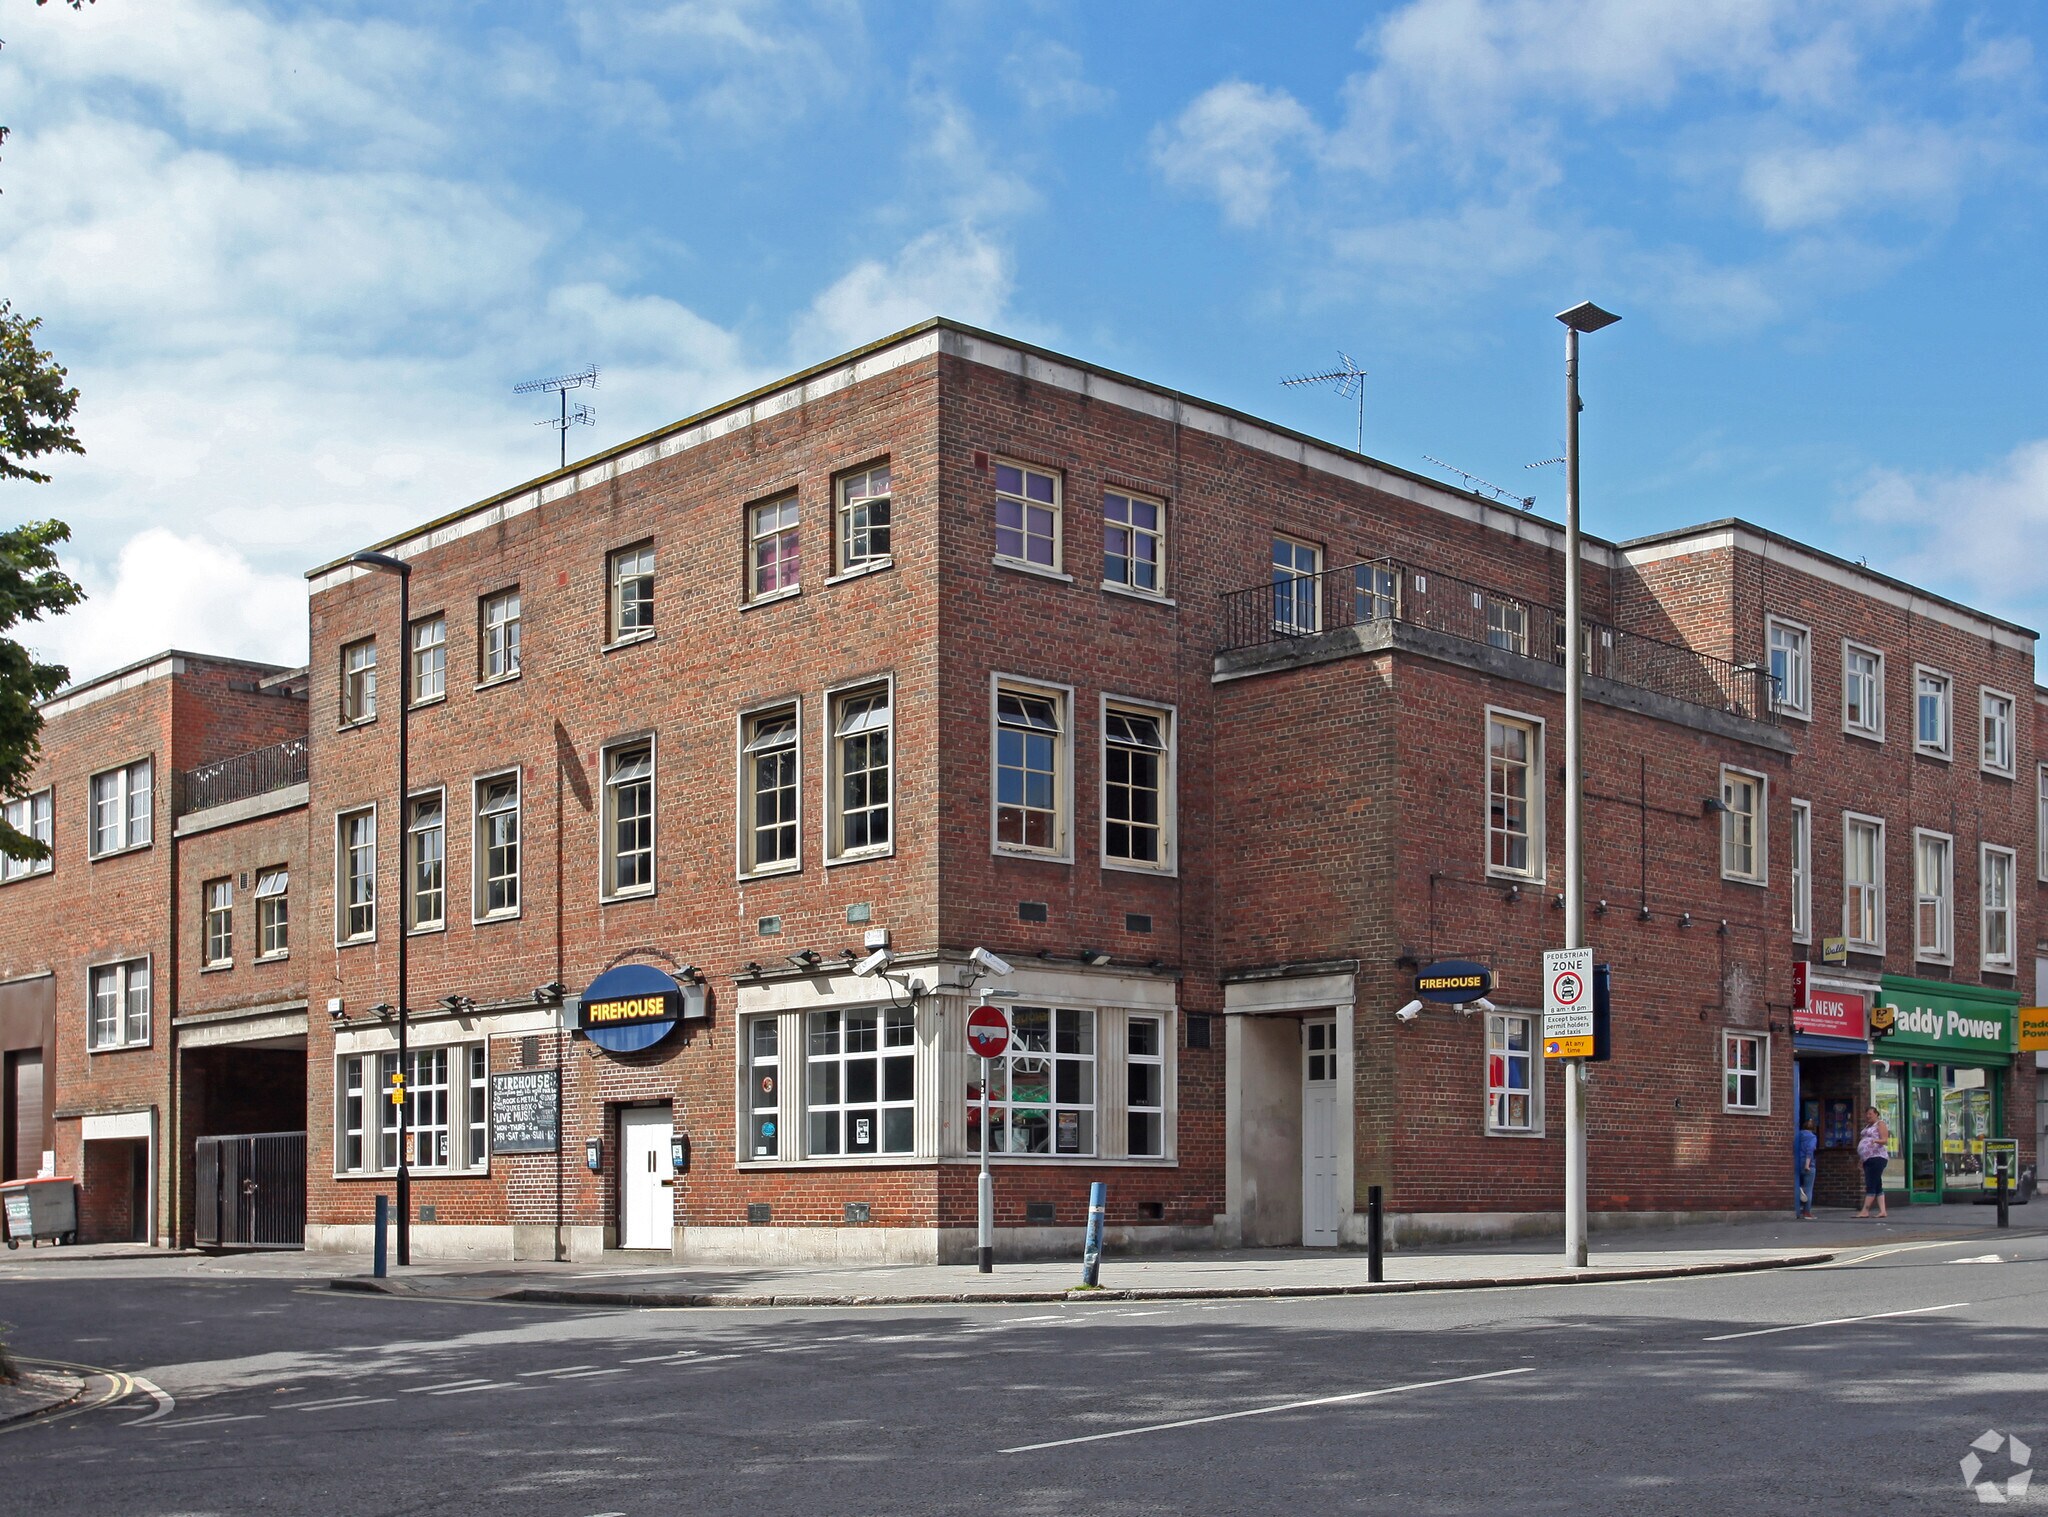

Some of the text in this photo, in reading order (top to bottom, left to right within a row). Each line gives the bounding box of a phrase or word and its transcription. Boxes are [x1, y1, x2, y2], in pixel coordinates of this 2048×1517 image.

[1547, 951, 1589, 960] PEDESTRIAN
[1553, 960, 1582, 971] ZONE
[1419, 976, 1481, 989] FIREHOUSE
[590, 996, 664, 1022] FIREHOUSE
[1815, 999, 1844, 1017] NEWS
[1548, 1015, 1568, 1023] Except
[1885, 1003, 2001, 1040] Paddy Power
[1546, 1022, 1566, 1030] permit
[2023, 1029, 2048, 1038] Pow
[497, 1074, 550, 1090] FIREHOUSE
[521, 1095, 538, 1103] METAL
[496, 1113, 511, 1123] LIVE
